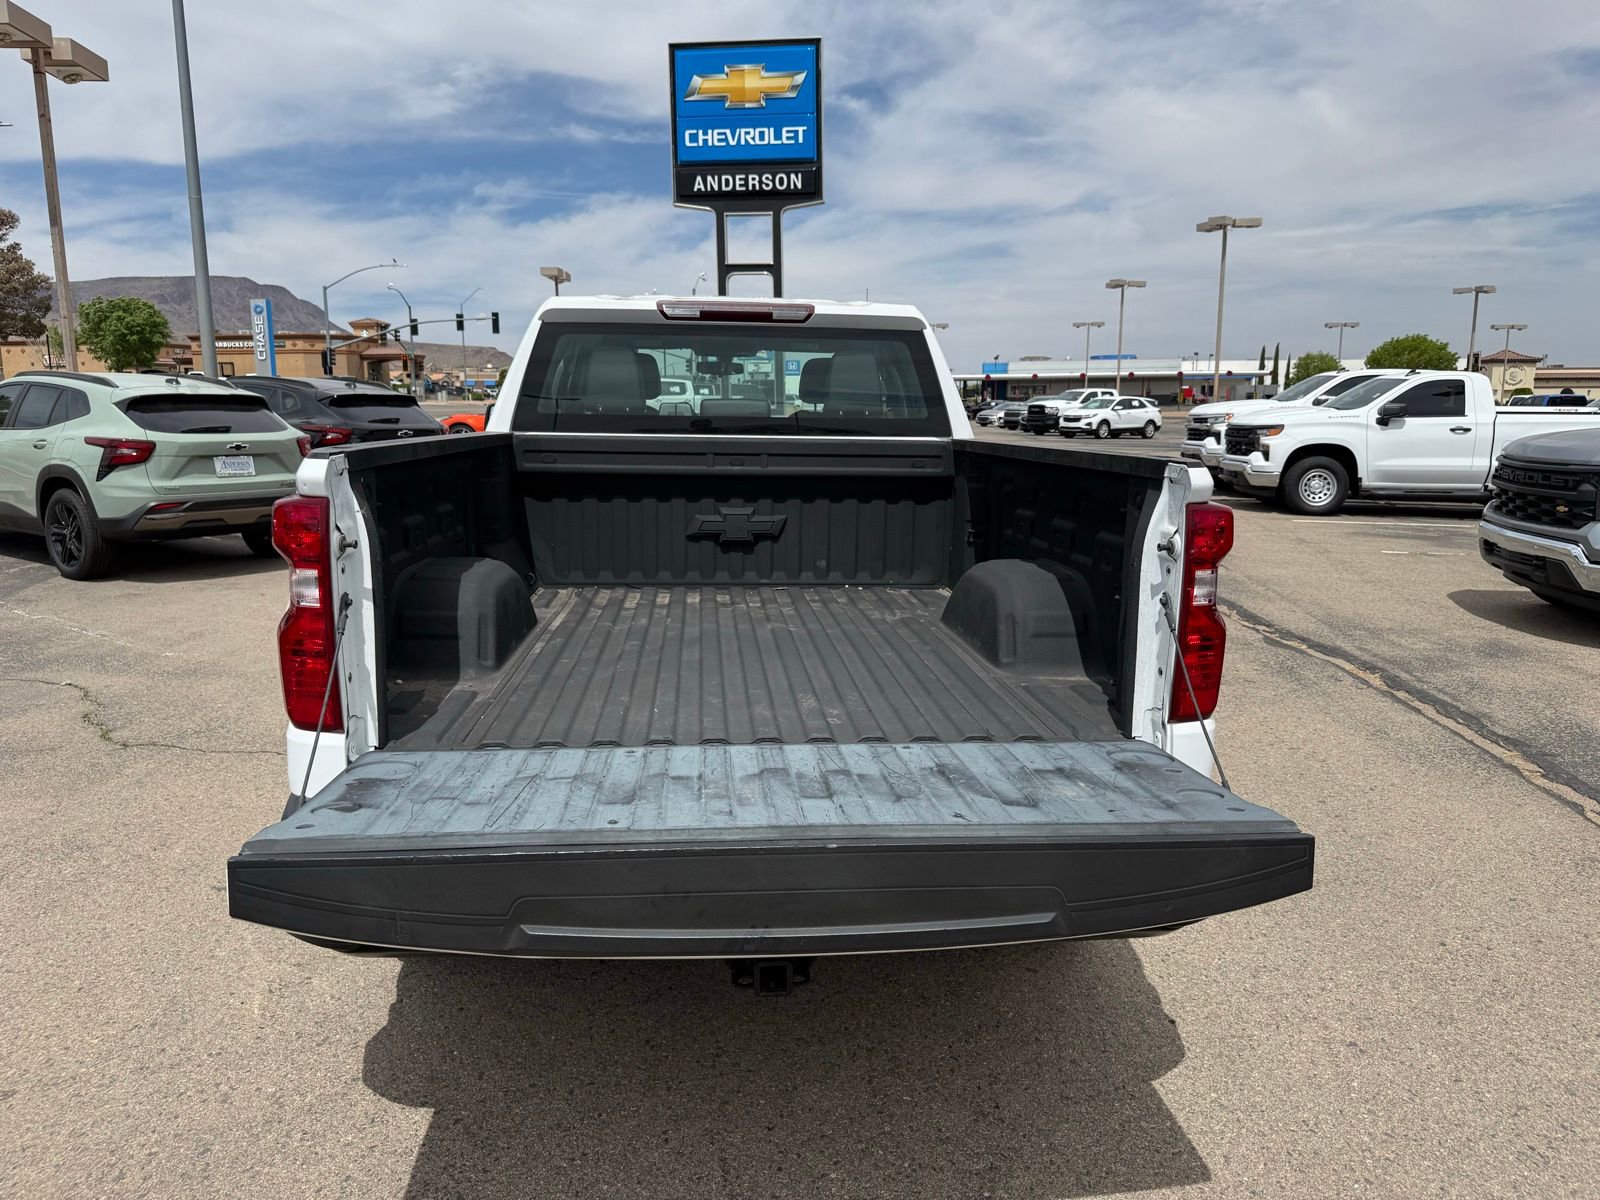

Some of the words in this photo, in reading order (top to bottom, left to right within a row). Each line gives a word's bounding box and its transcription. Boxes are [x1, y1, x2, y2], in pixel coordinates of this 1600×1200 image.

[684, 126, 807, 147] CHEVROLET
[693, 172, 802, 192] ANDERSON
[254, 316, 266, 360] CHASE
[1496, 467, 1580, 489] HEVROLET
